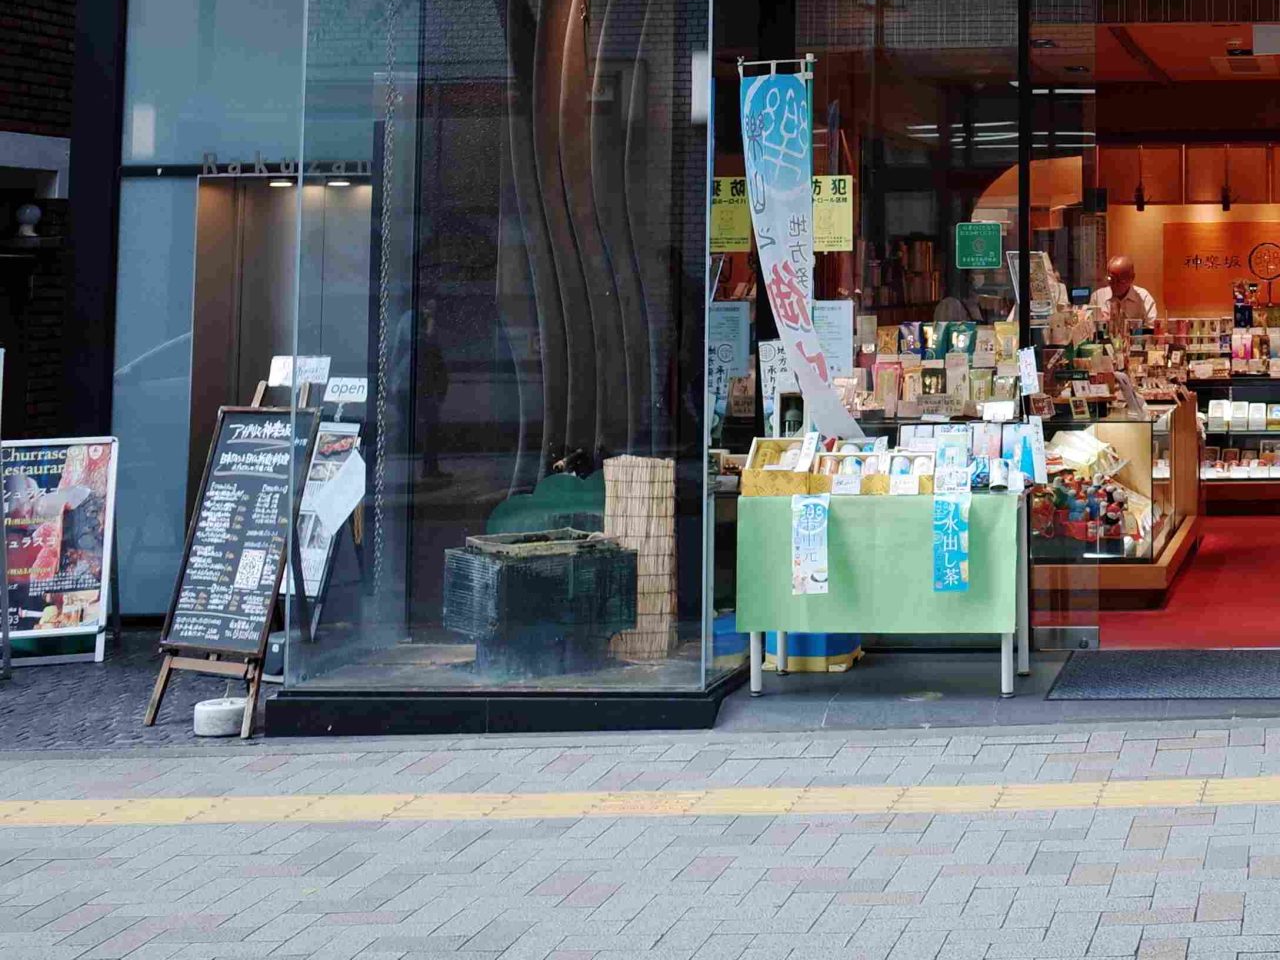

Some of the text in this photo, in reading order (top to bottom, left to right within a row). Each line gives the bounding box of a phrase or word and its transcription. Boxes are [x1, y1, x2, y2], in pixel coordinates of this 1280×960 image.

[202, 151, 372, 175] Rakuzan
[330, 382, 366, 397] open
[4, 536, 57, 549] ュラスコ
[942, 517, 960, 587] 水出し茶
